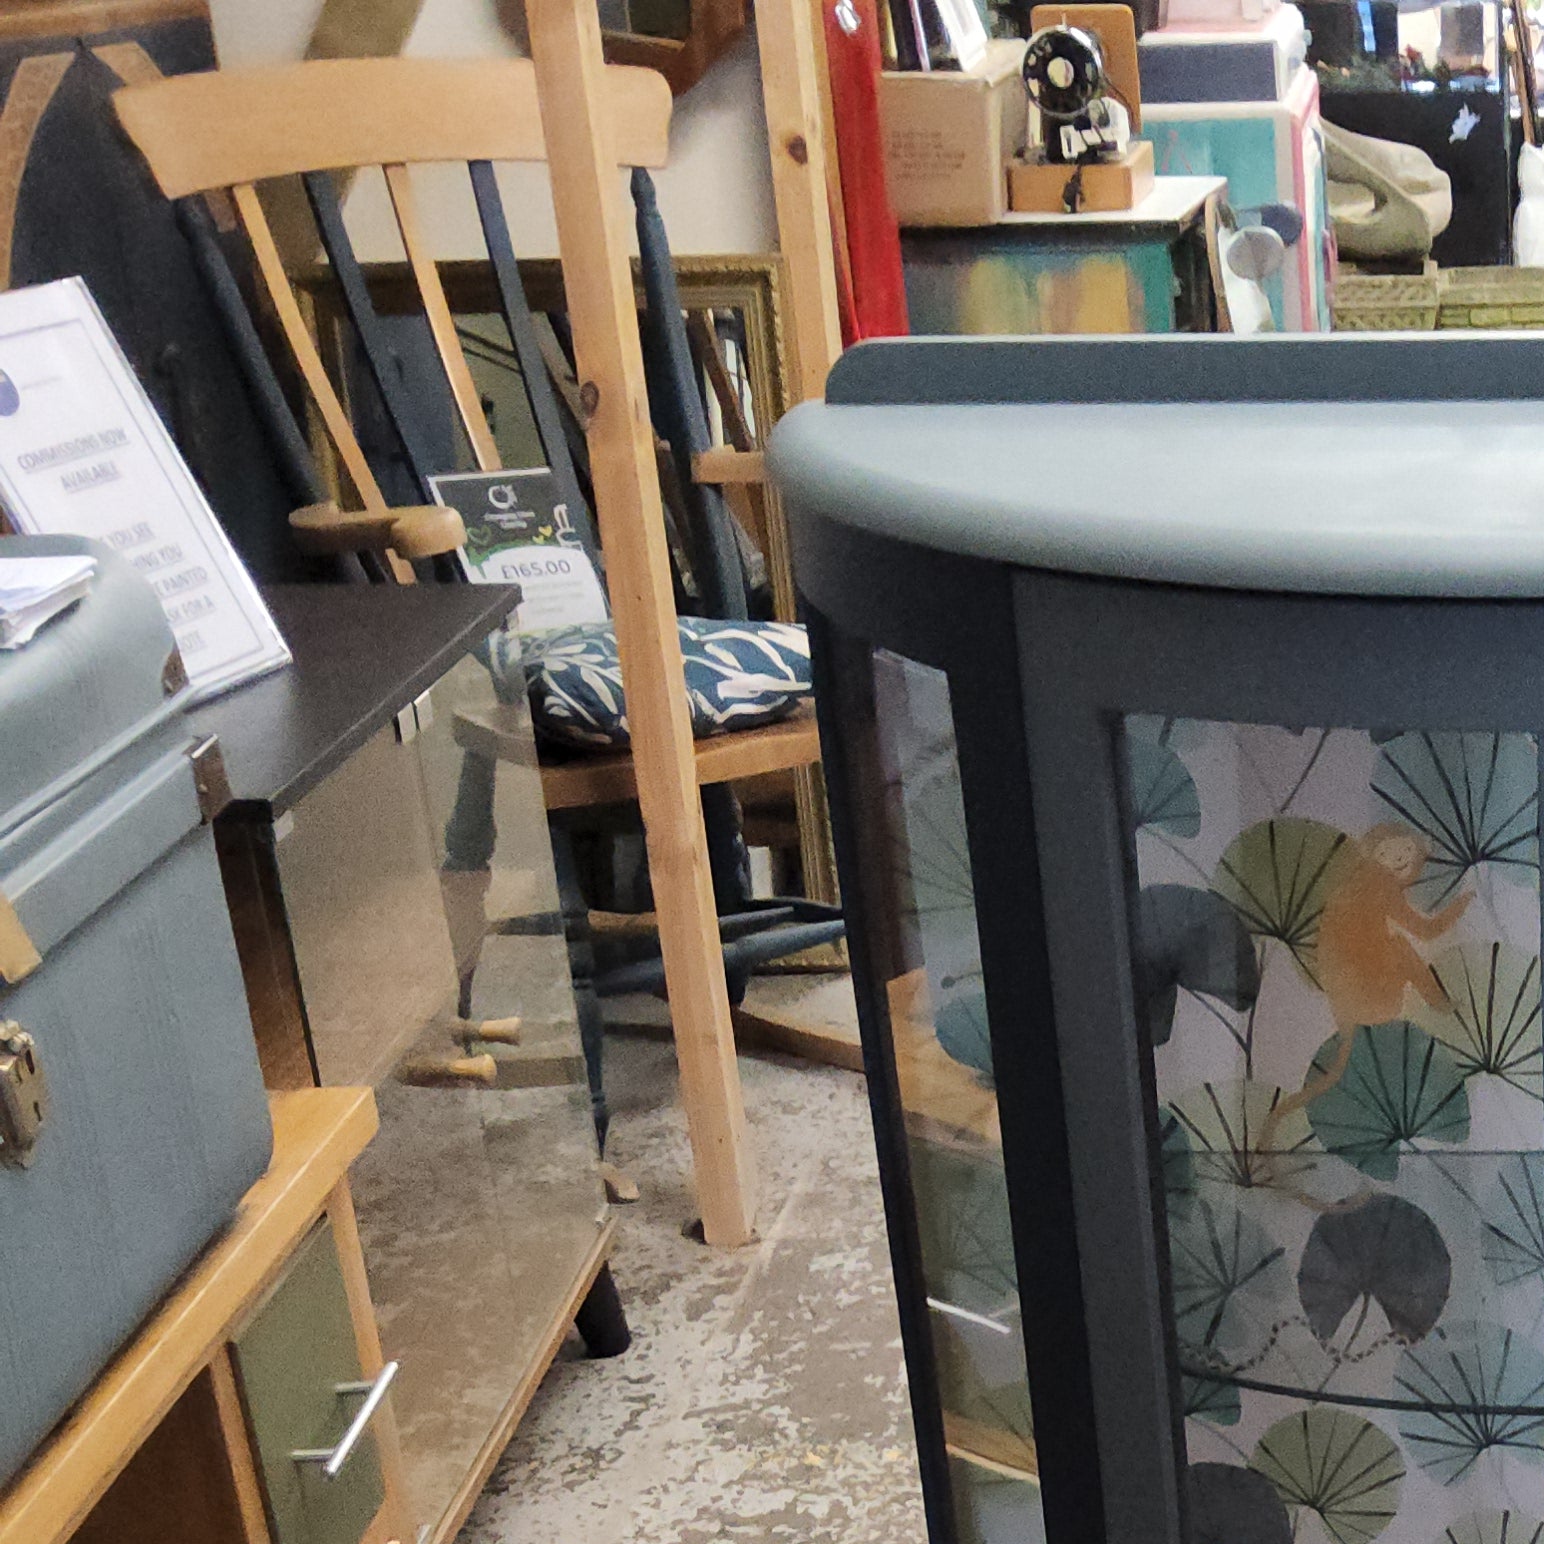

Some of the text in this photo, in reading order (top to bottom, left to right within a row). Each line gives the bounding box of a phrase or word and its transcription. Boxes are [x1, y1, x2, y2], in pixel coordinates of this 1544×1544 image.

[18, 434, 100, 470] COMMISSIONS
[60, 460, 119, 490] AVAILABLE
[158, 542, 183, 563] YOU
[163, 566, 208, 591] PAINTED
[501, 560, 572, 579] £165.00
